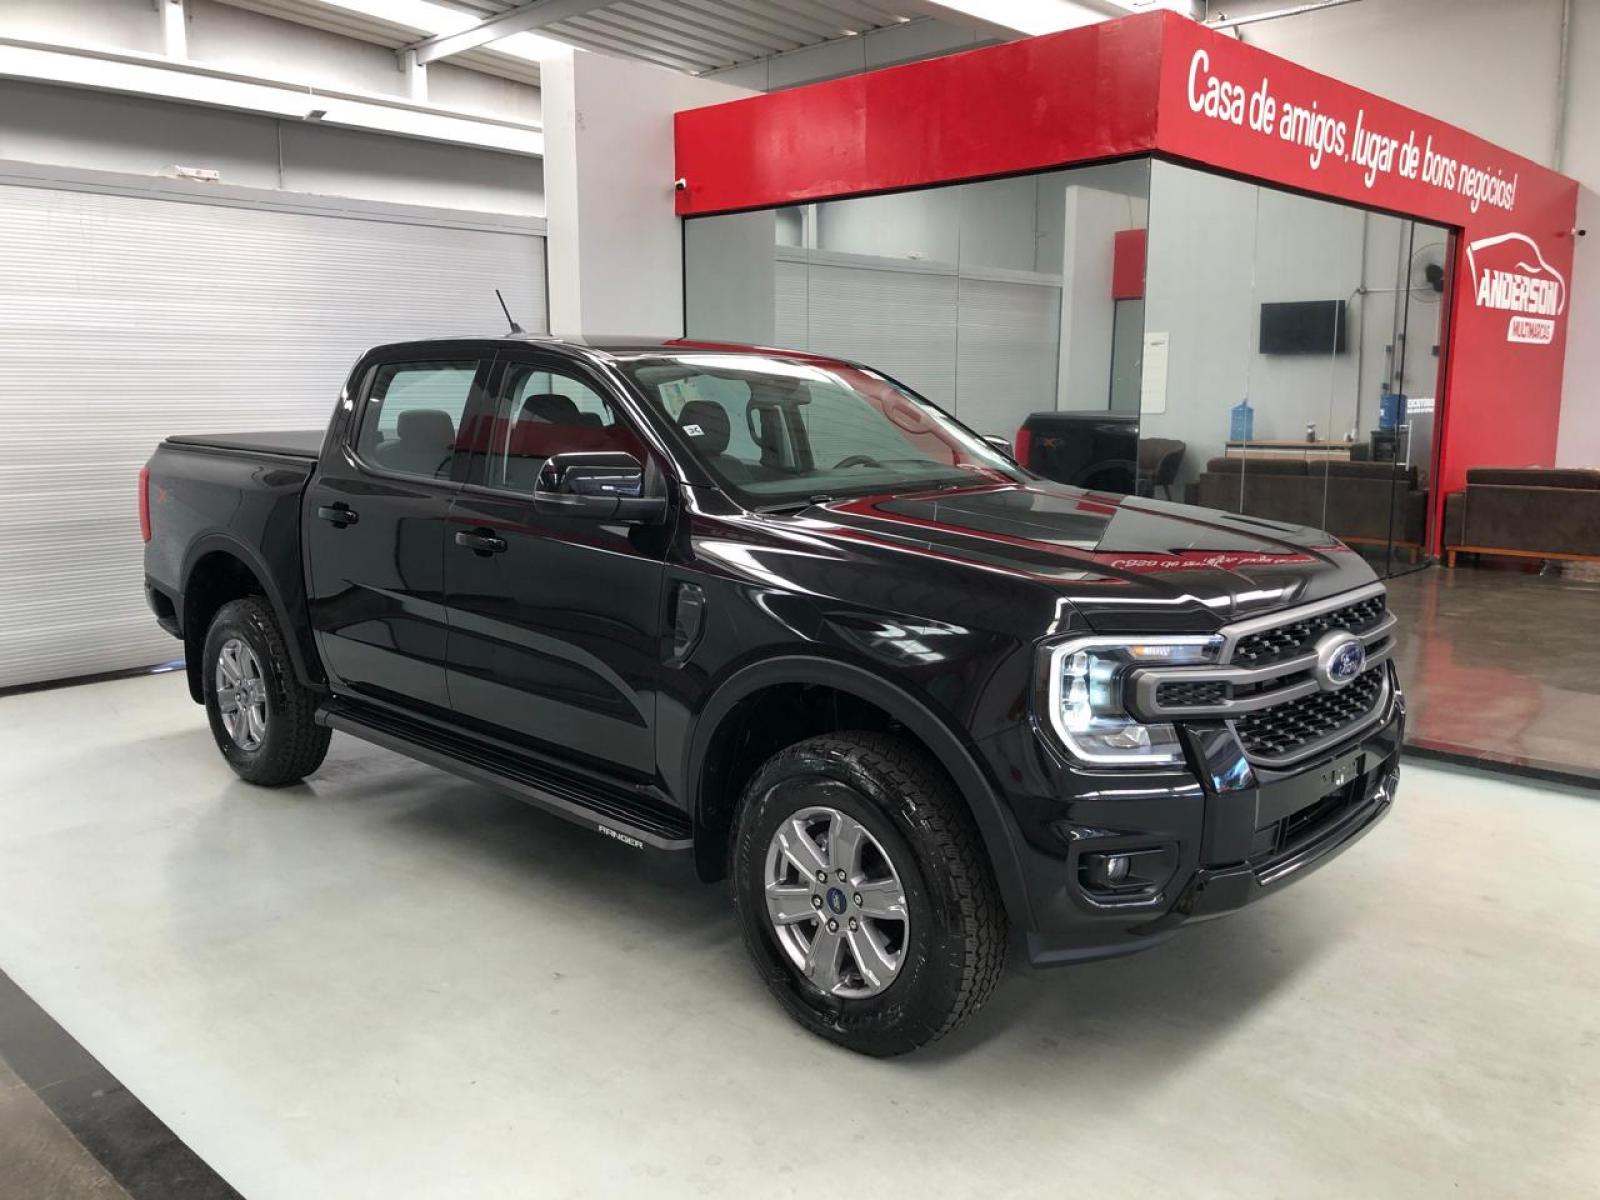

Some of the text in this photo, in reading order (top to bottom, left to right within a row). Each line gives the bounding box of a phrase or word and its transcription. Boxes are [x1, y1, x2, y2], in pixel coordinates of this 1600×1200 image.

[1188, 49, 1518, 214] Casa de amigos, lugar de bons negócios!
[1476, 268, 1559, 316] ANDERSON
